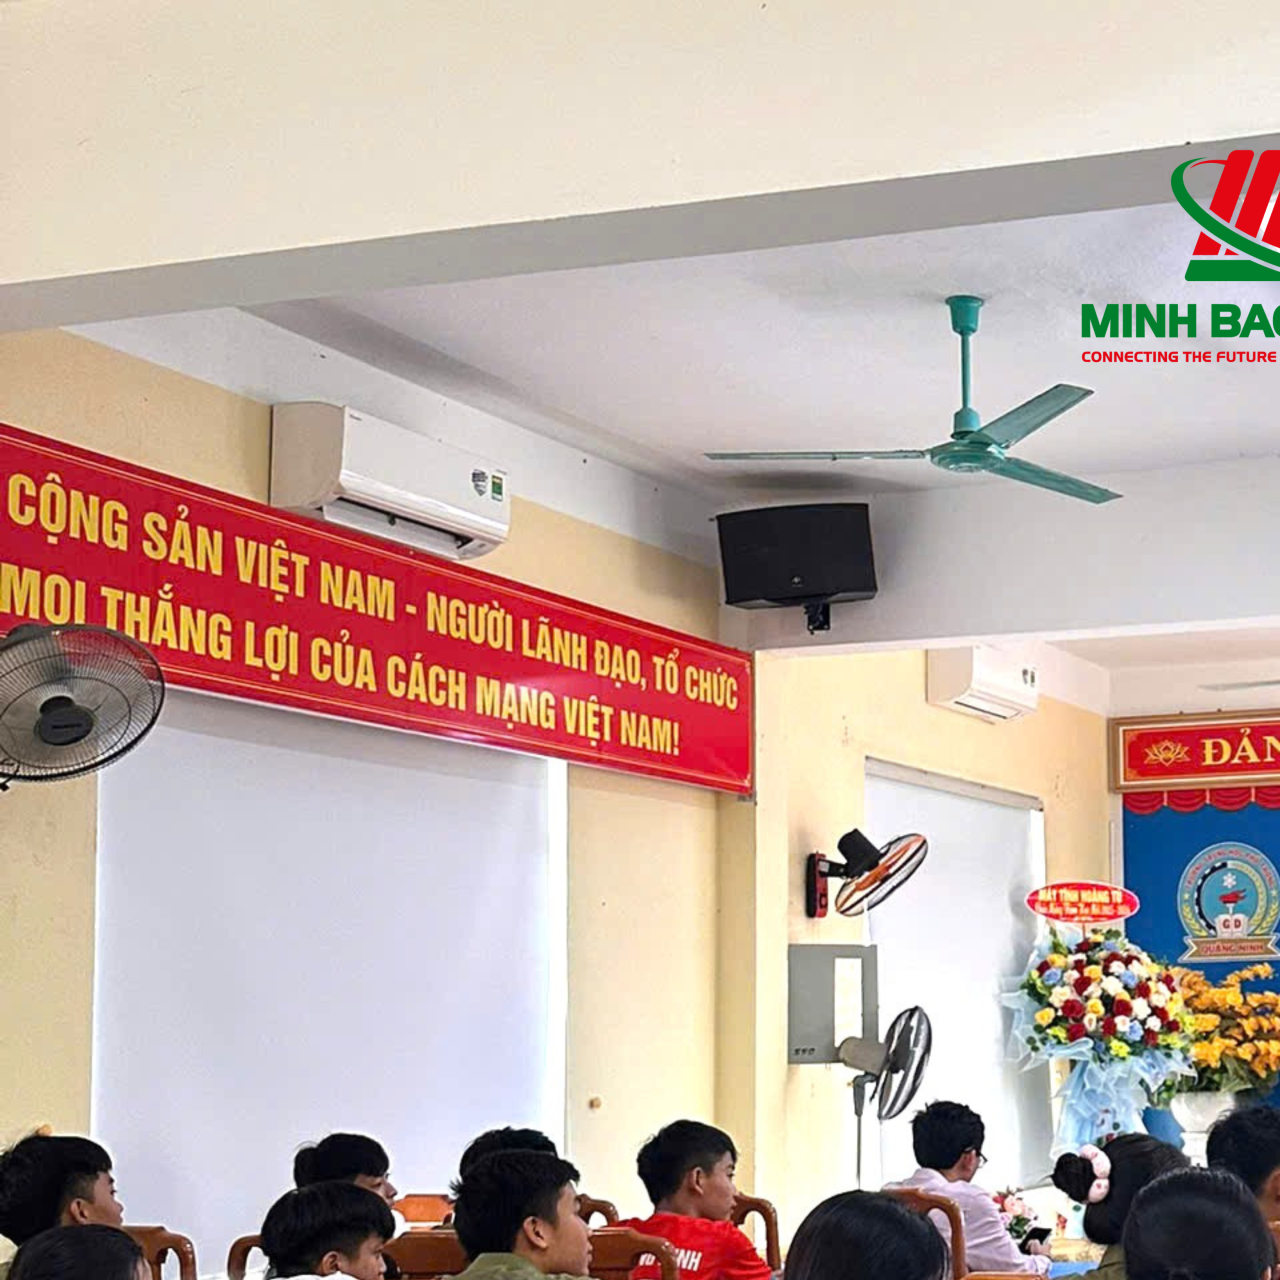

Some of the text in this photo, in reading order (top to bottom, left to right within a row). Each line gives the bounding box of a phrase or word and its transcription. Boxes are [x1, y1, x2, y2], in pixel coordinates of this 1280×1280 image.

[7, 474, 128, 551] CỘNG
[143, 504, 223, 576] SẢN
[235, 536, 309, 602] VIỆT
[320, 561, 395, 621] NAM
[427, 591, 513, 652] NGƯỜI
[521, 616, 588, 673] LÃNH
[595, 638, 647, 691] ĐẠO,
[652, 648, 679, 694] TỔ
[685, 665, 738, 710] CHỨC
[101, 583, 232, 661] THẮNG
[244, 620, 299, 681] LỢI
[310, 628, 377, 693] CỦA
[386, 653, 467, 711] CÁCH
[475, 676, 555, 730] MẠNG
[564, 695, 614, 747] VIỆT
[620, 709, 680, 756] NAM!
